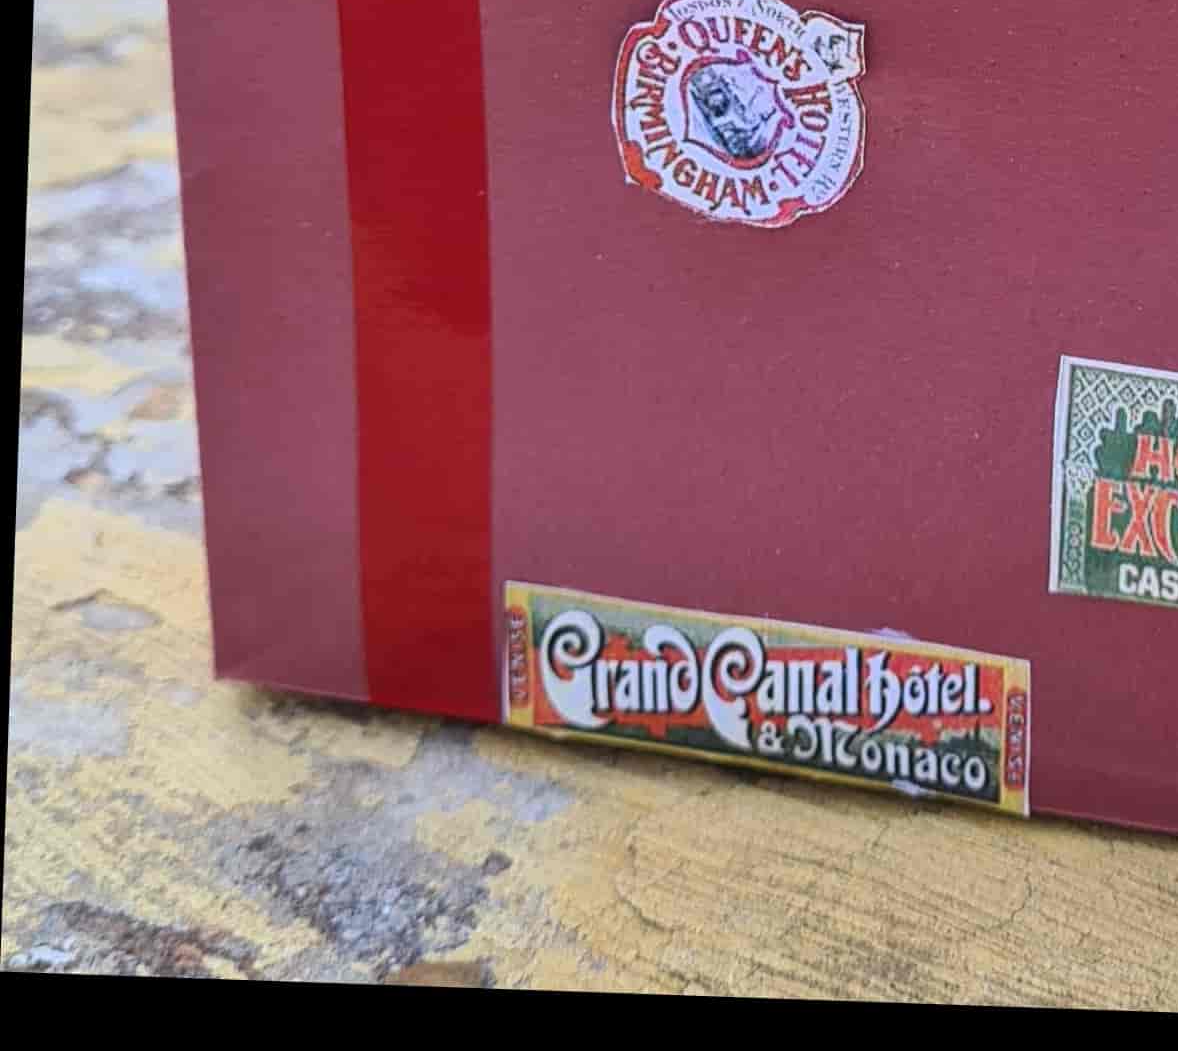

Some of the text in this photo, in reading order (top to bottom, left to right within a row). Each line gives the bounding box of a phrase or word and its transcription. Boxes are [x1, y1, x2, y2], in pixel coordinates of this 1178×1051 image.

[628, 39, 770, 215] BIRMINGHAM
[771, 81, 832, 187] HOTEL
[541, 609, 699, 728] Grand
[703, 627, 862, 748] Canal
[756, 716, 987, 790] & Monaco
